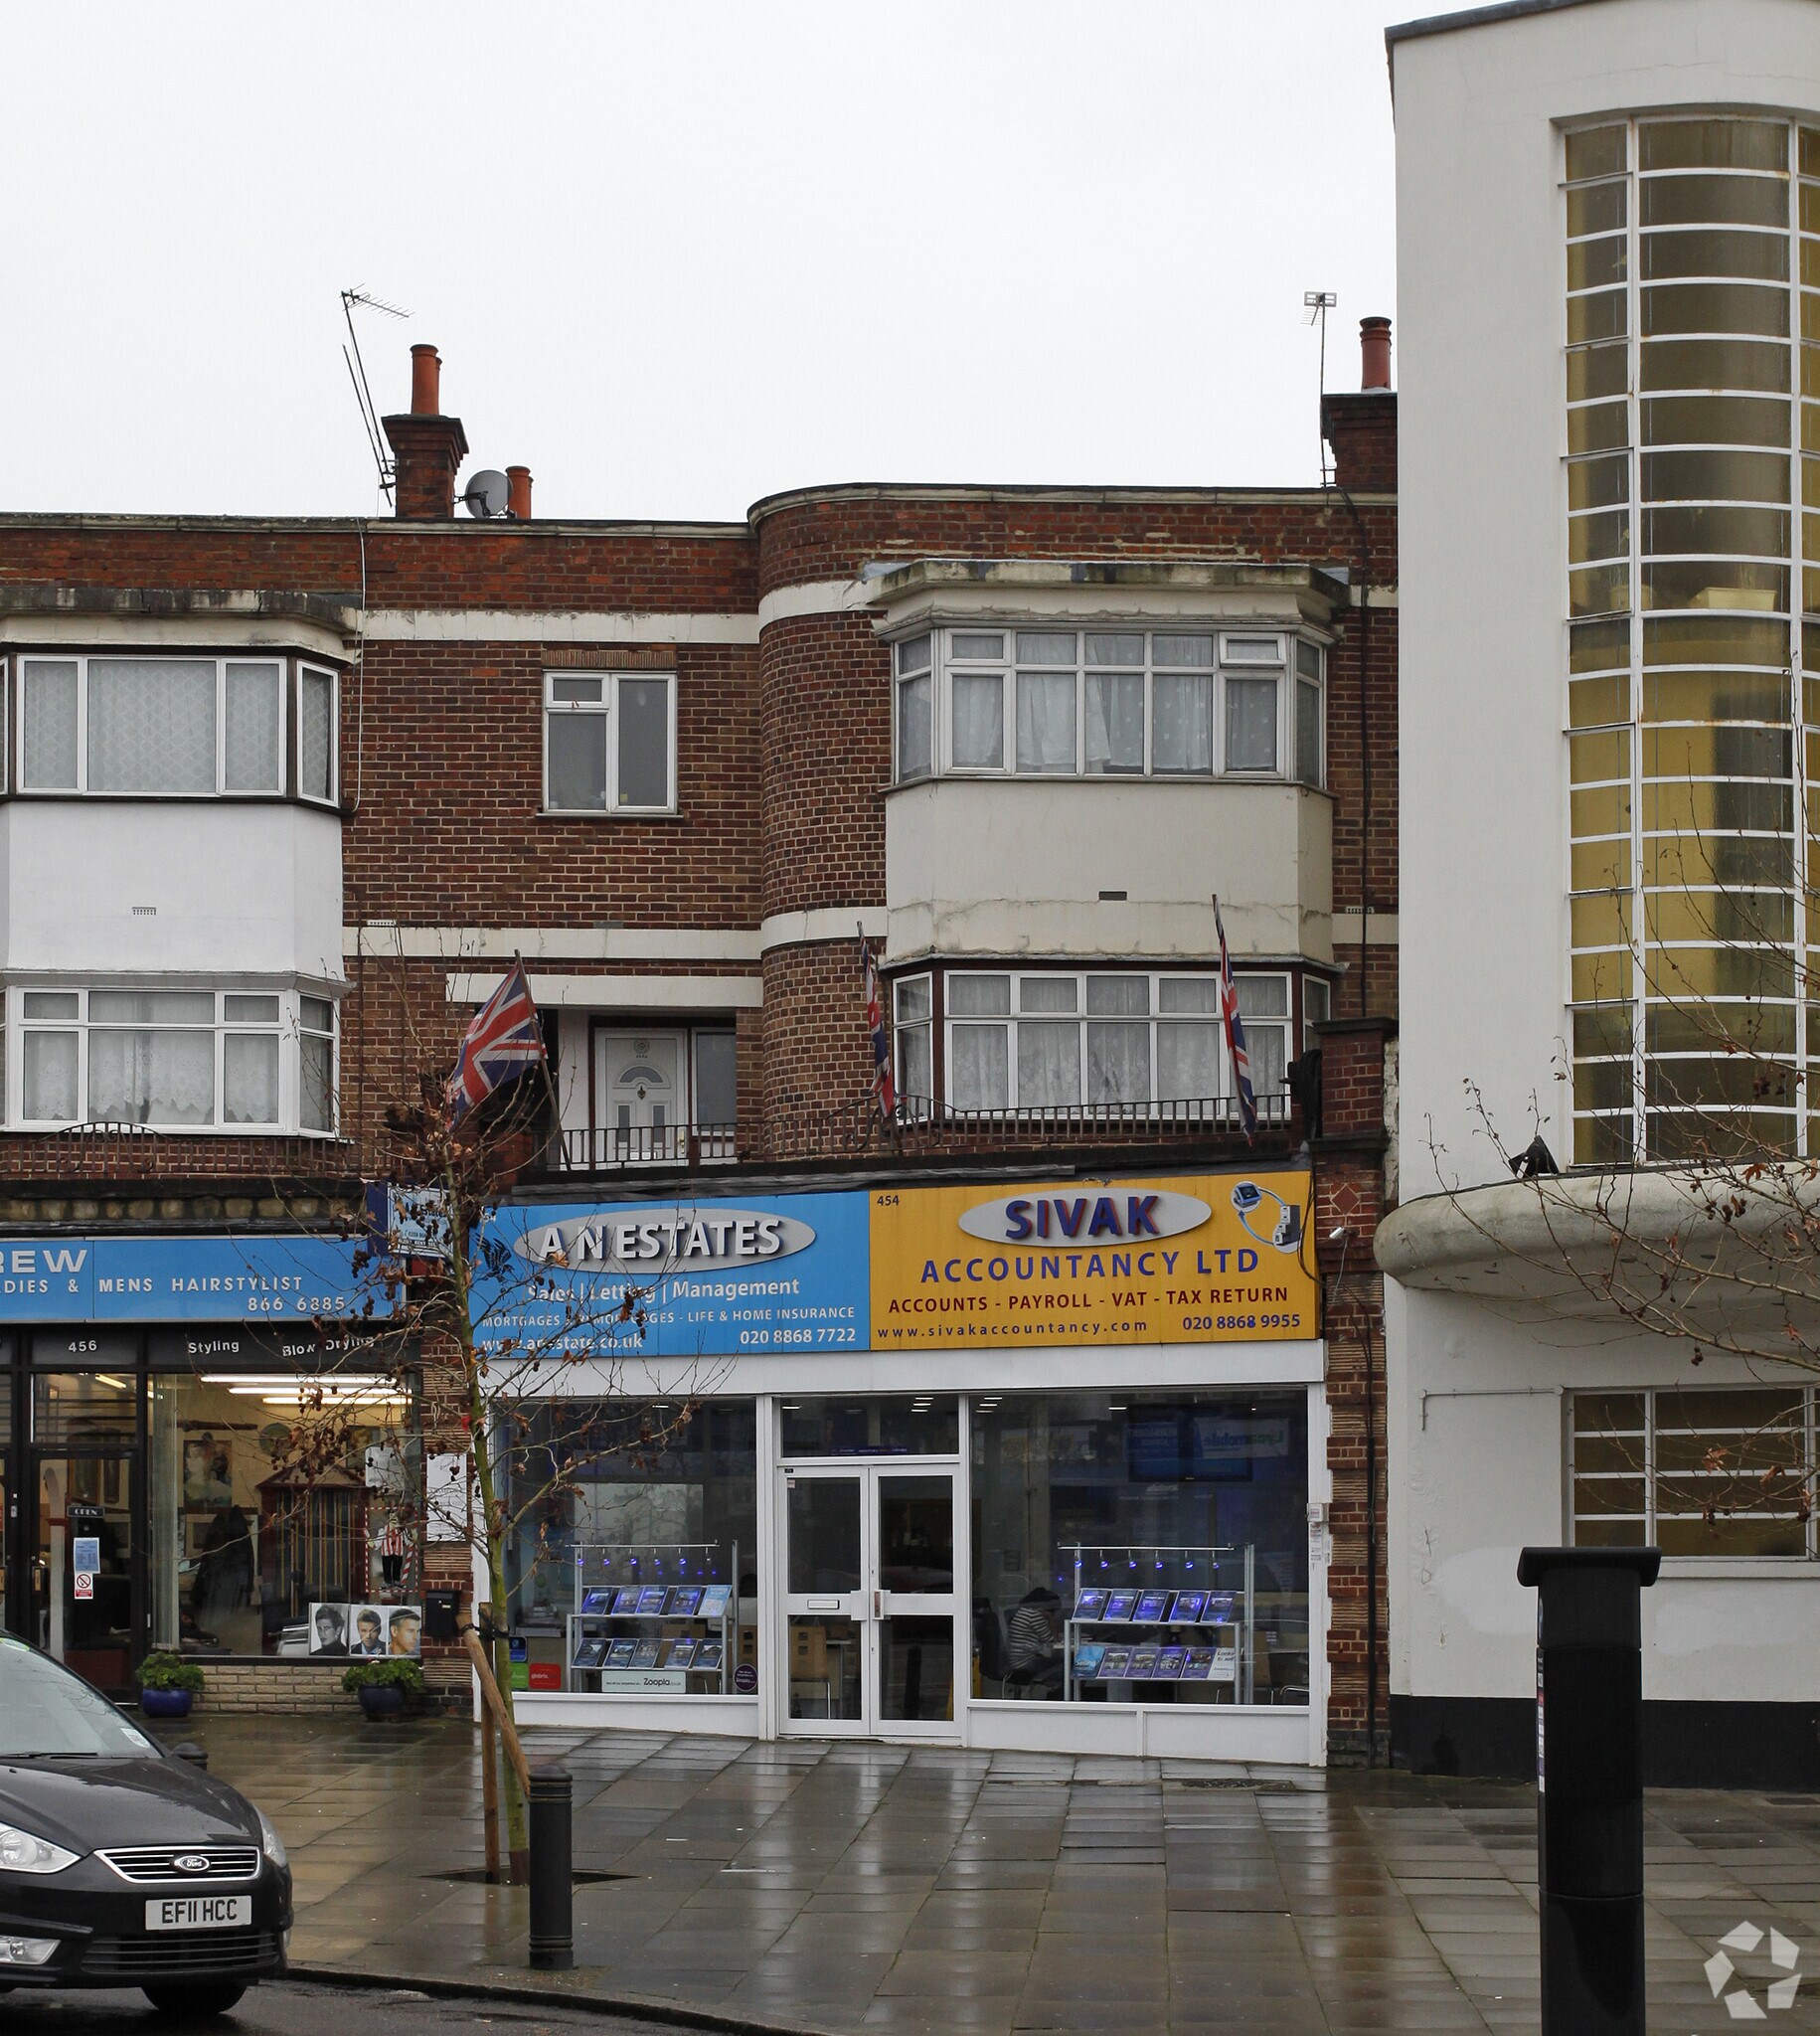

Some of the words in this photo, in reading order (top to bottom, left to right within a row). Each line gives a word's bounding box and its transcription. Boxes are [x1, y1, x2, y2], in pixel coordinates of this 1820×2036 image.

[877, 1195, 900, 1206] 454
[1005, 1195, 1160, 1239] SIVAK
[578, 1226, 603, 1260] N
[615, 1219, 781, 1259] ESTATES
[0, 1250, 87, 1273] EW
[920, 1251, 1180, 1283] ACCOUNTANCY
[1197, 1248, 1259, 1274] LTD
[0, 1279, 48, 1293] DIES
[68, 1278, 80, 1293] &
[99, 1277, 152, 1292] MENS
[171, 1277, 302, 1291] HAIRSTYLIST
[673, 1278, 799, 1301] Management
[248, 1297, 283, 1311] 866
[297, 1296, 345, 1311] 6885
[889, 1296, 988, 1313] ACCOUNTS
[1009, 1293, 1092, 1309] PAYROLL
[1111, 1291, 1148, 1307] VAT
[1166, 1289, 1202, 1305] TAX
[1210, 1286, 1288, 1303] RETURN
[482, 1315, 560, 1327] MORTGAGES
[688, 1310, 715, 1322] LIFE
[719, 1310, 728, 1321] &
[733, 1309, 772, 1321] HOME
[776, 1306, 856, 1319] INSURANCE
[1182, 1317, 1212, 1330] 020
[1217, 1315, 1255, 1329] 8868
[1260, 1314, 1300, 1327] 9955
[740, 1330, 769, 1345] 020
[773, 1329, 813, 1343] 8868
[817, 1328, 856, 1342] 7722
[878, 1321, 1147, 1338] www.sivakaccountancy.com
[69, 1340, 97, 1353] 456
[189, 1341, 240, 1354] Styling
[162, 1901, 198, 1924] EF11
[203, 1899, 238, 1921] HCC
